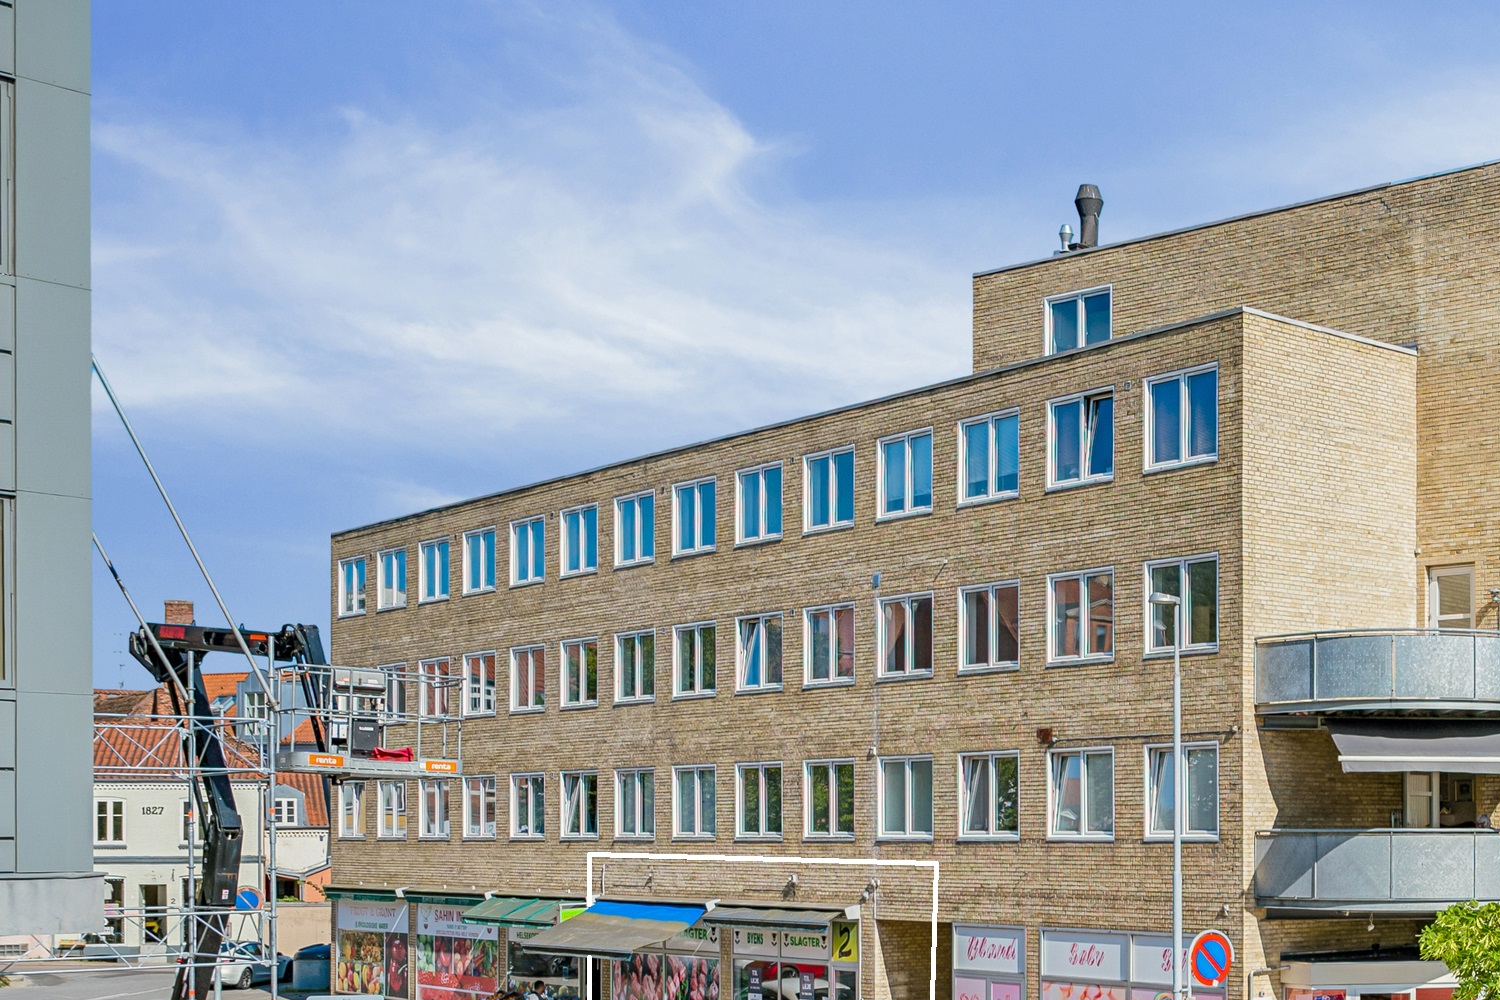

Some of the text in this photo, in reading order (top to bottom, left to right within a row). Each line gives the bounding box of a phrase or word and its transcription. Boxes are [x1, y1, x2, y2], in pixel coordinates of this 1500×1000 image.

[315, 756, 337, 765] renta
[142, 806, 164, 815] 1827
[790, 936, 820, 948] SLAGTER
[967, 936, 1016, 961] Bland
